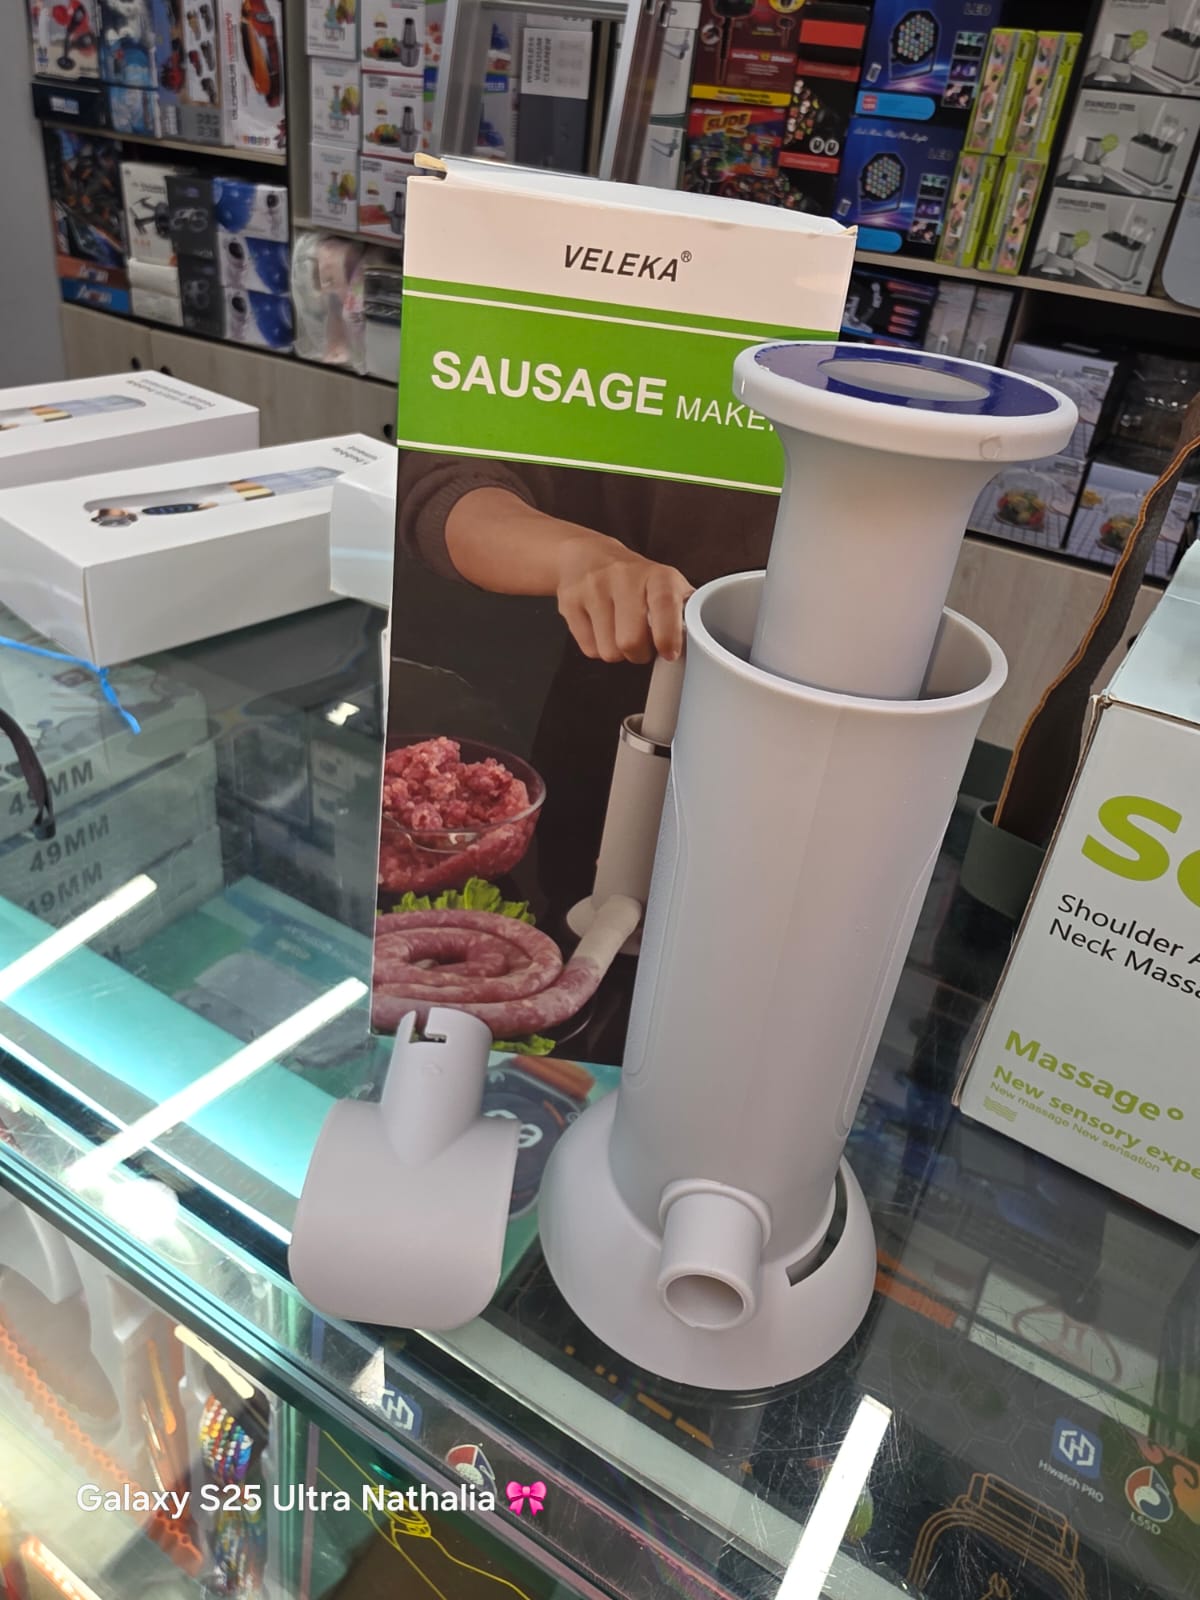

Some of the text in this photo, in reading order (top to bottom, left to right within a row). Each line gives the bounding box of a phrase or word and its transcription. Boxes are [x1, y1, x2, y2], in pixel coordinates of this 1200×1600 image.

[431, 350, 775, 433] SAUSAGE MAKE
[30, 814, 109, 873] 49MM
[1049, 918, 1118, 962] Neck
[1057, 893, 1184, 957] Shoulder
[990, 1081, 1161, 1173] New massage New sensation
[993, 1065, 1045, 1100] New
[1048, 1096, 1142, 1150] sensory
[1081, 1483, 1105, 1503] PRO
